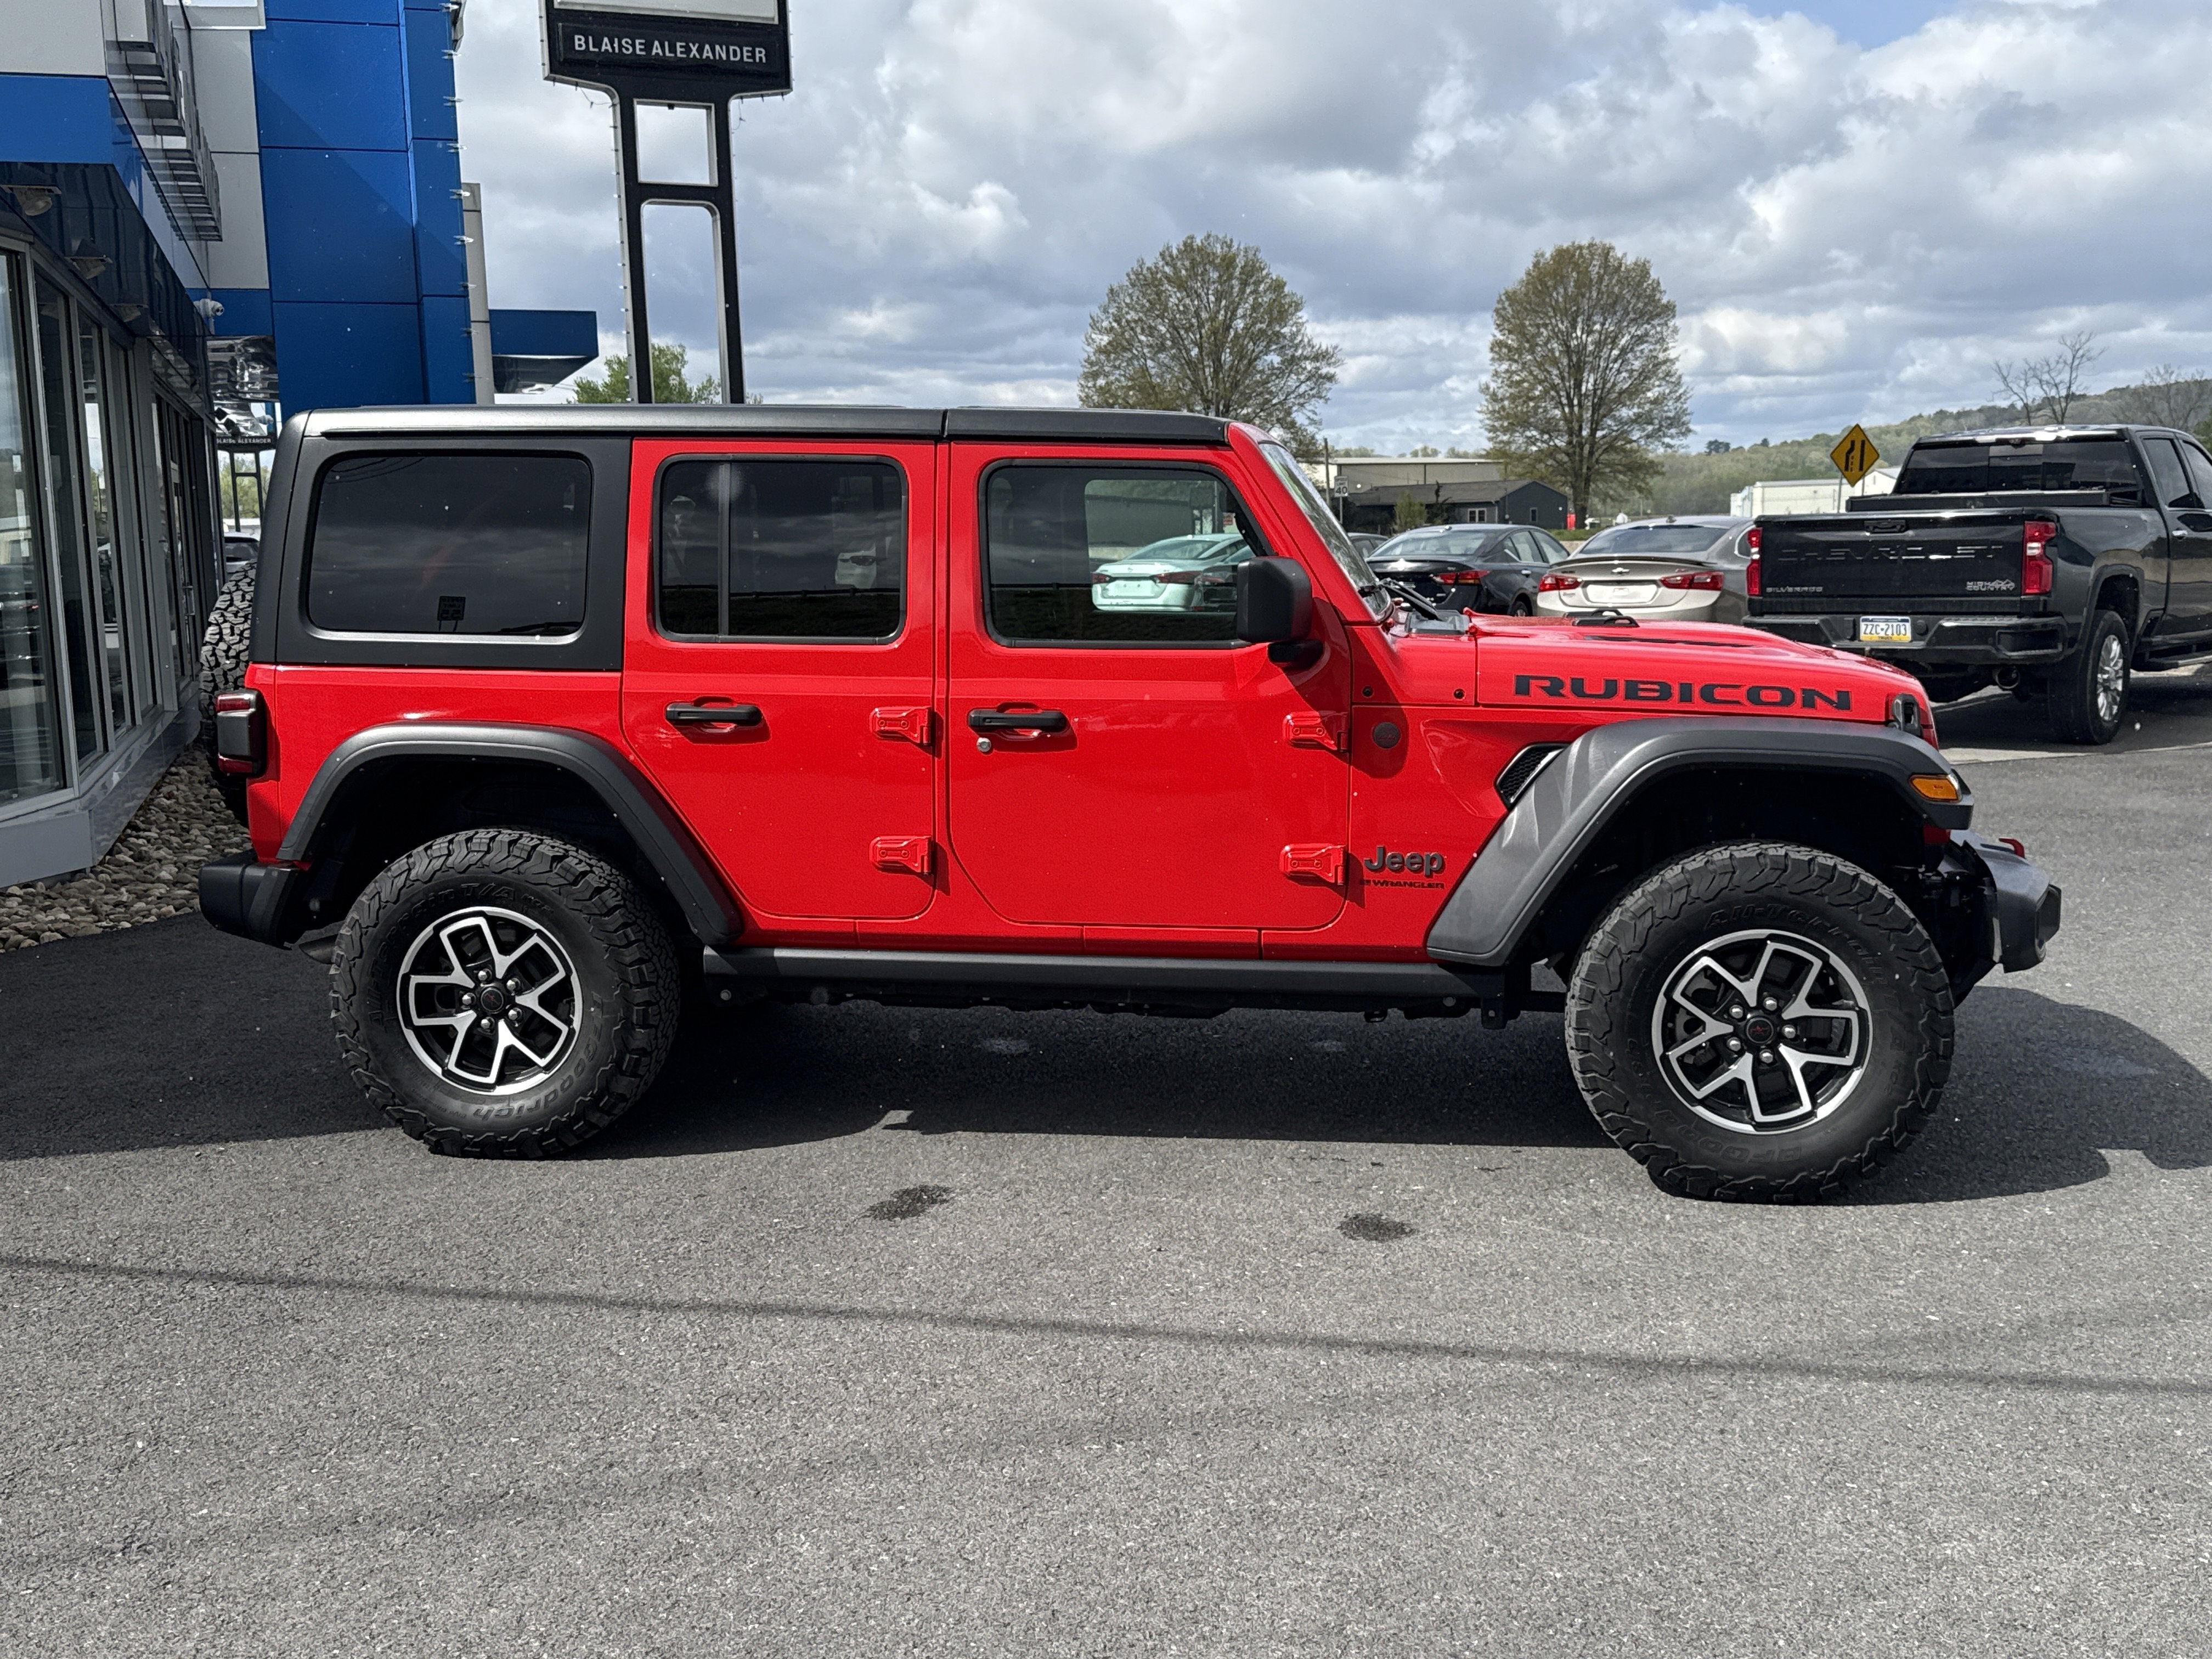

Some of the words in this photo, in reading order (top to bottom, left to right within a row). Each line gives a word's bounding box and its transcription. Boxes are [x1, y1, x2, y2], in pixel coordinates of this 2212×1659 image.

[574, 35, 646, 55] BLAISE
[651, 40, 767, 64] ALEXANDER
[1335, 486, 1348, 494] 40
[1514, 674, 1853, 711] RUBICON
[1364, 845, 1445, 876] Jeep
[1373, 879, 1445, 889] WRANGLER
